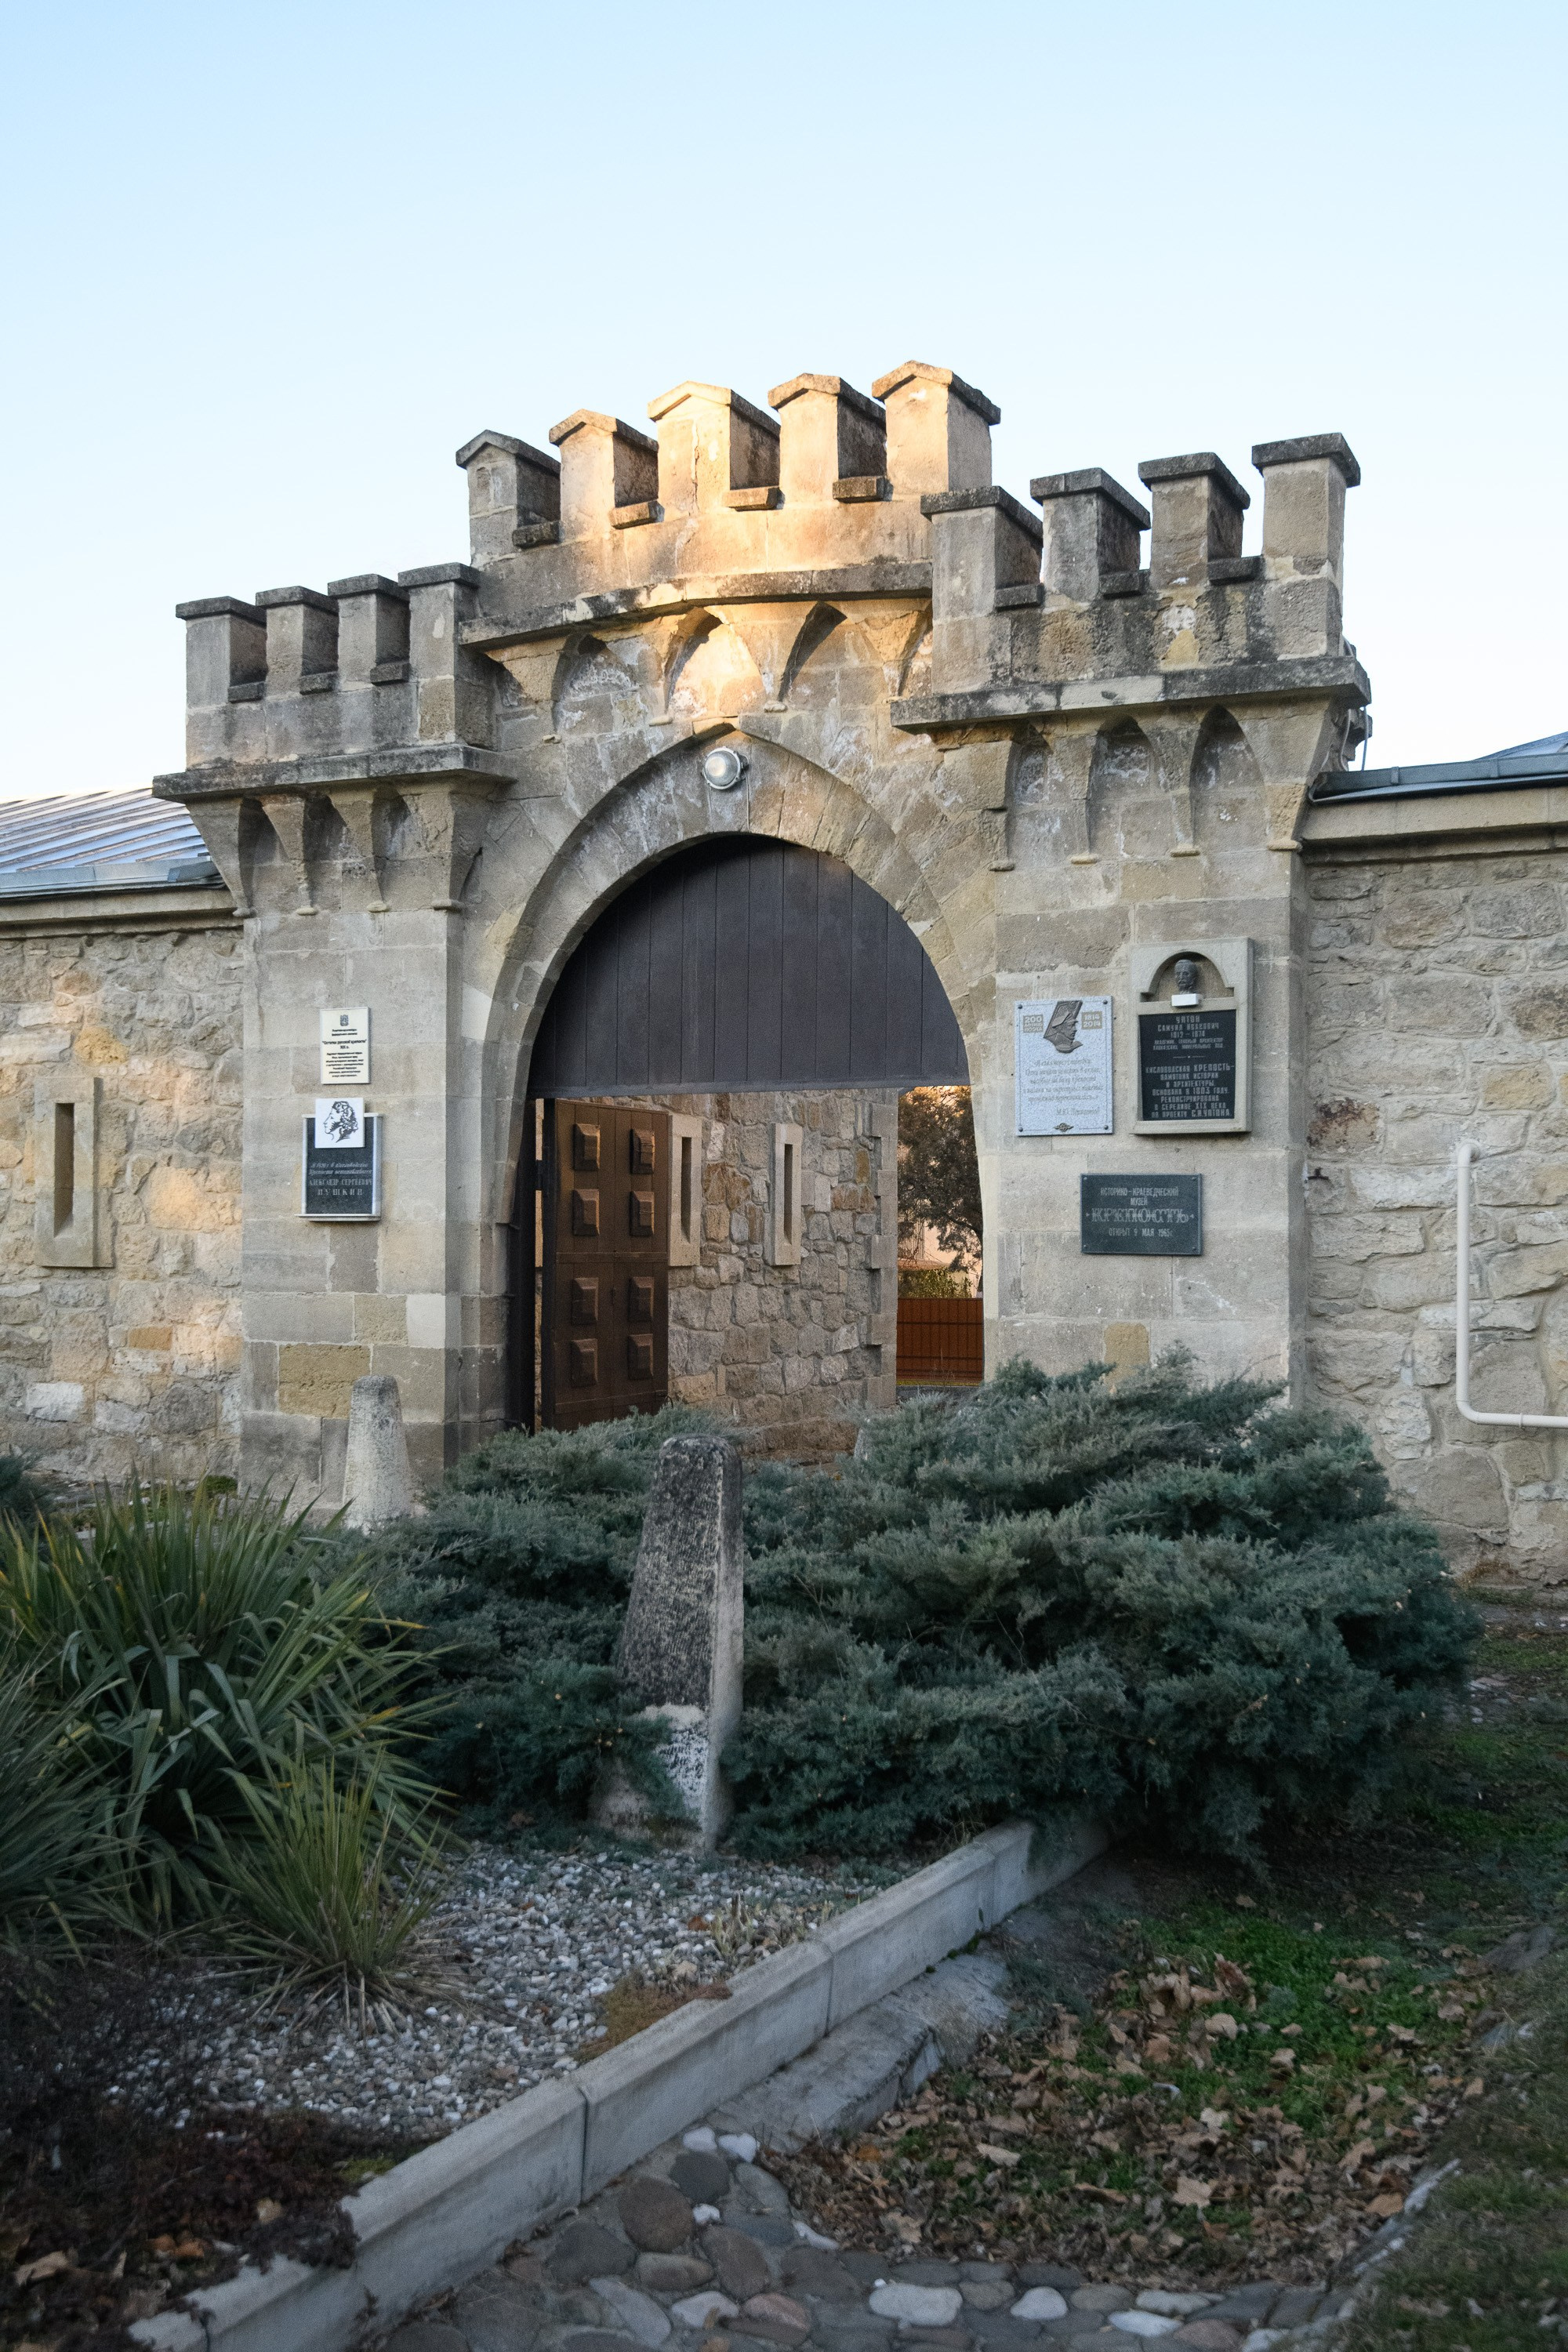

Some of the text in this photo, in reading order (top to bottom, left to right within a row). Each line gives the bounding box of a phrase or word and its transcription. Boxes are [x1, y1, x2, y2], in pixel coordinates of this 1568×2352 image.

[1131, 1196, 1148, 1206] МУЗЕЙ
[1109, 1228, 1131, 1236] ОТКРЫТ
[1134, 1228, 1138, 1236] 9
[1142, 1228, 1154, 1236] МАЯ
